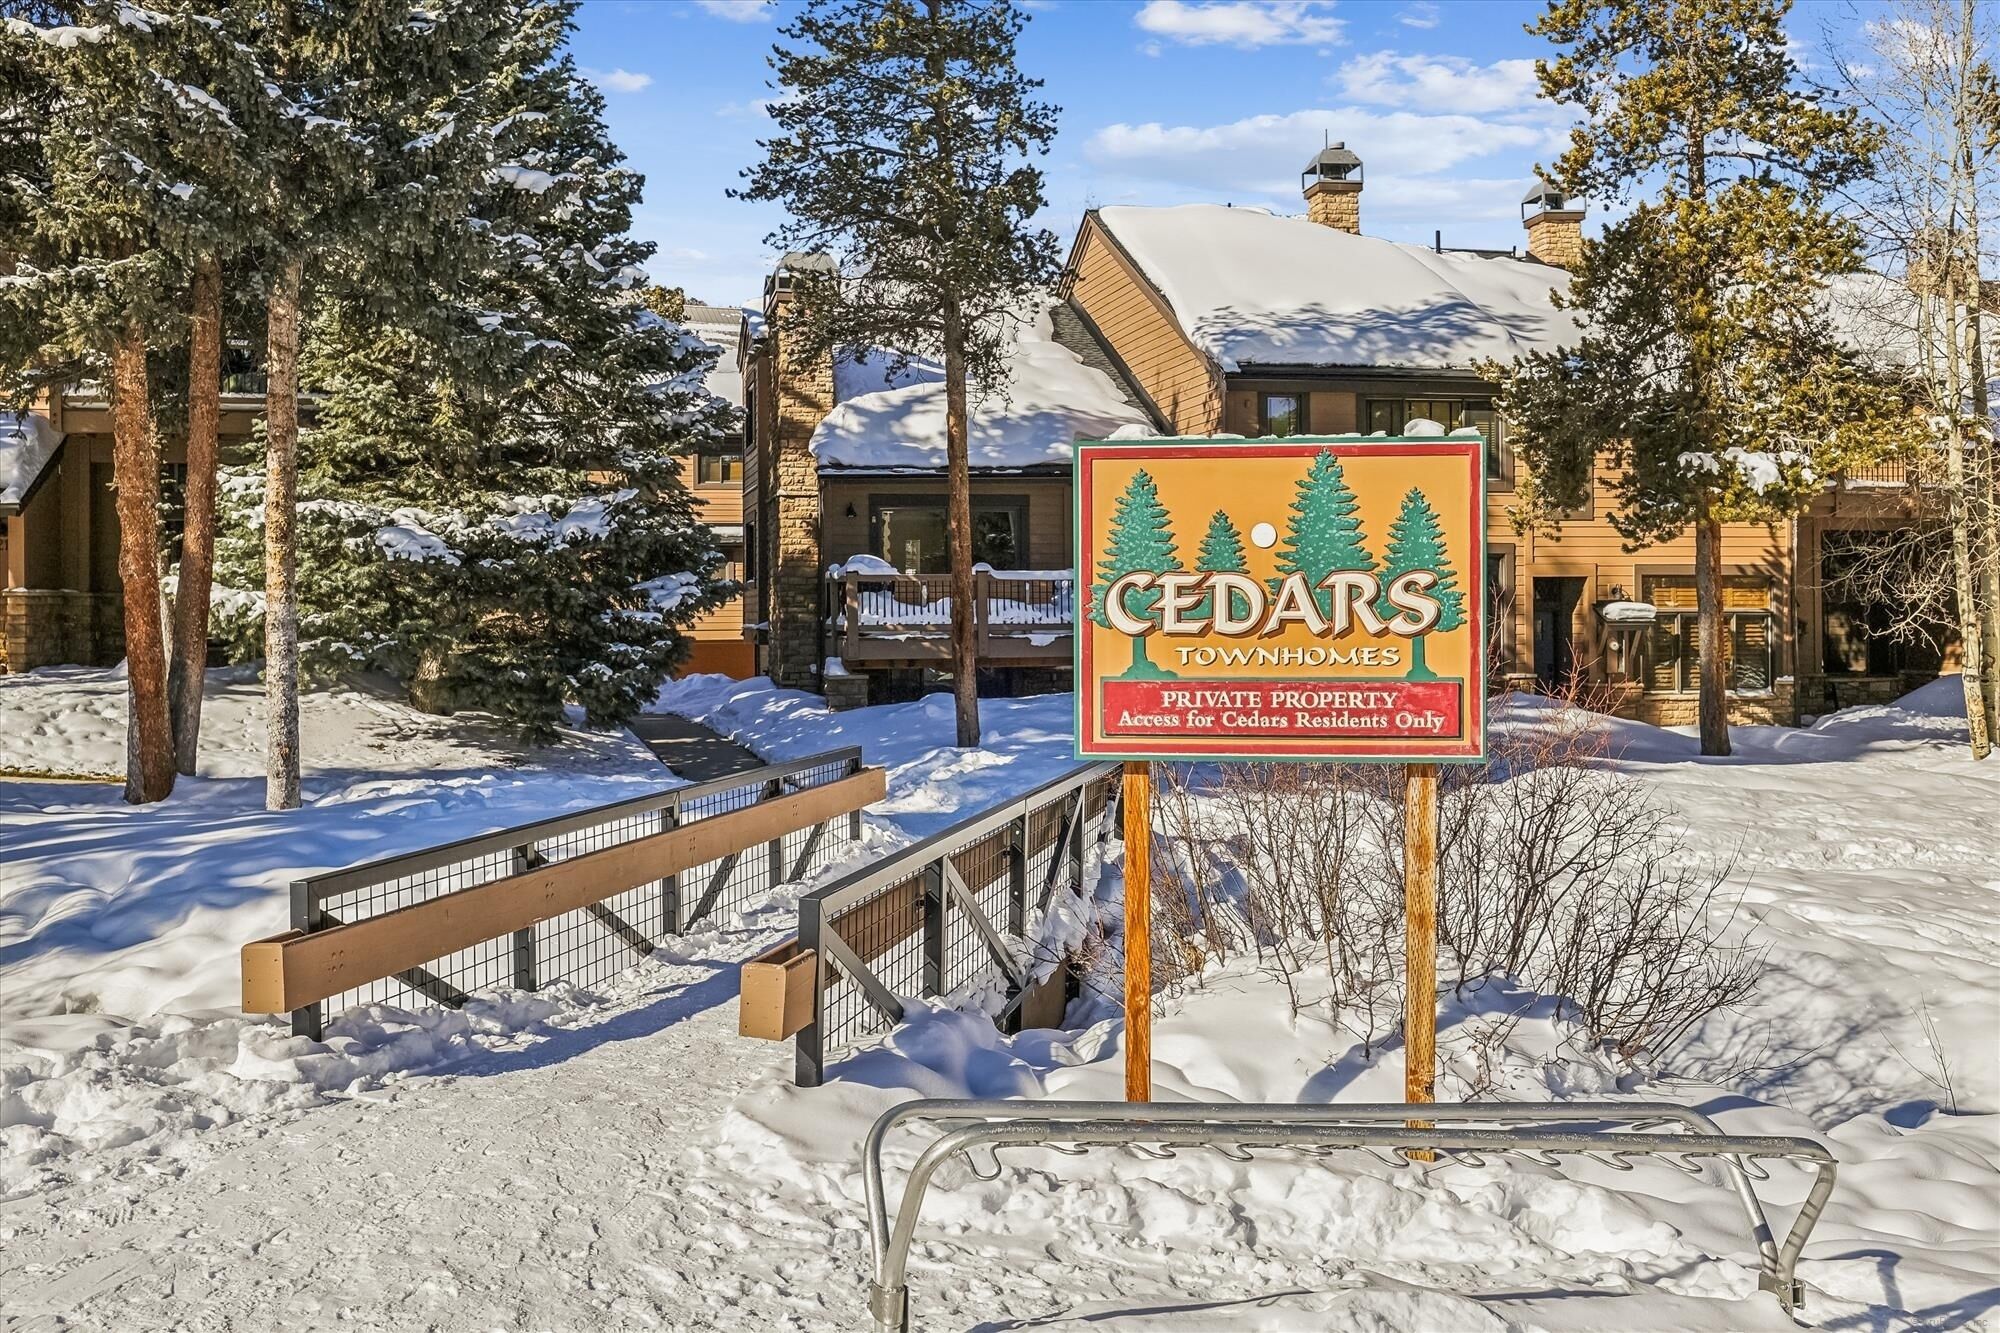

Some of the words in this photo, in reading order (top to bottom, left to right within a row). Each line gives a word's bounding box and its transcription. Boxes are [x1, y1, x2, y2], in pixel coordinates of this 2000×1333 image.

[1104, 570, 1441, 638] CEDARS
[1174, 647, 1401, 667] TOWNHOMES
[1160, 690, 1262, 709] PRIVATE
[1270, 690, 1398, 709] PROPERTY
[1118, 711, 1180, 728] Access
[1186, 709, 1215, 728] for
[1222, 710, 1288, 728] Cedars
[1295, 711, 1388, 729] Residents
[1395, 710, 1446, 734] Only
